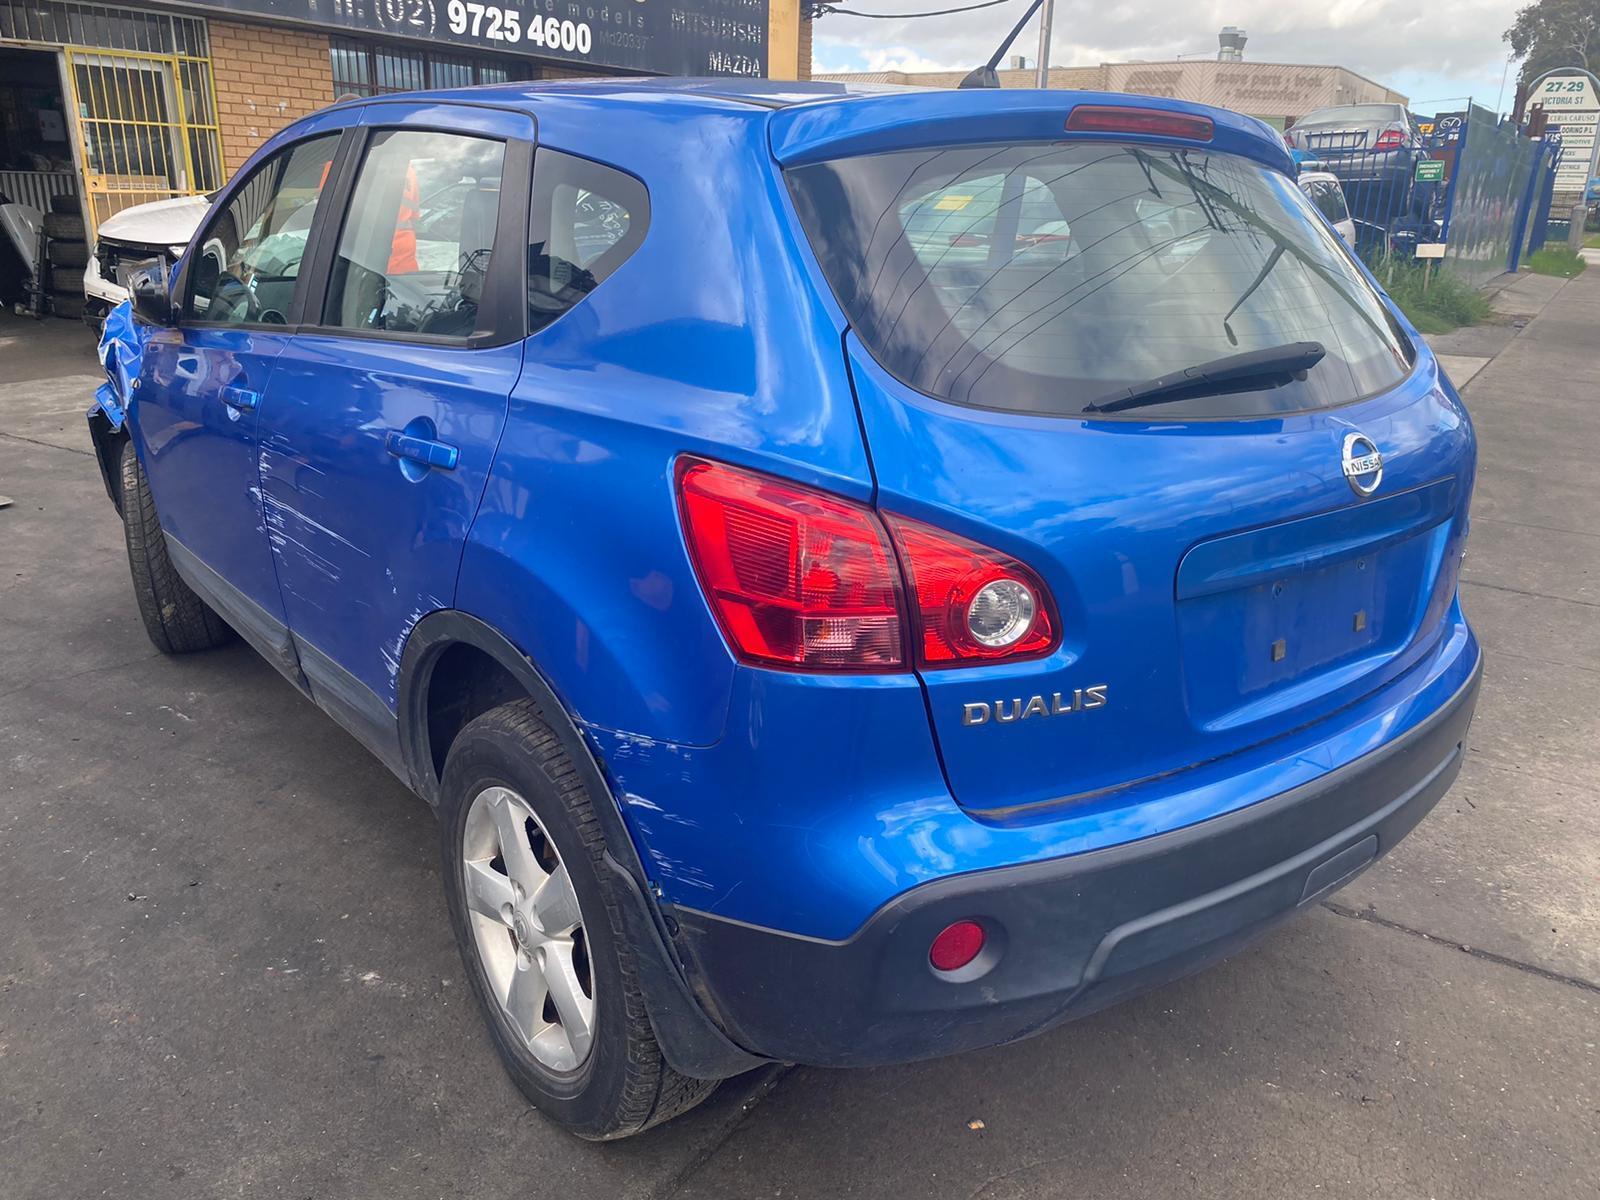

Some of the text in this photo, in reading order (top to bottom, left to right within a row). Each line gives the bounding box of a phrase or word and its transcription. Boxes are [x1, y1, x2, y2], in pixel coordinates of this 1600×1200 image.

[447, 0, 521, 43] 9725
[527, 14, 592, 54] 4600
[567, 2, 644, 28] models
[671, 8, 761, 43] MITSUBISHI
[708, 51, 761, 77] MAZDA
[1545, 81, 1584, 93] 27-29
[1542, 96, 1584, 105] VICTORIA ST
[962, 683, 1108, 726] DUALIS
